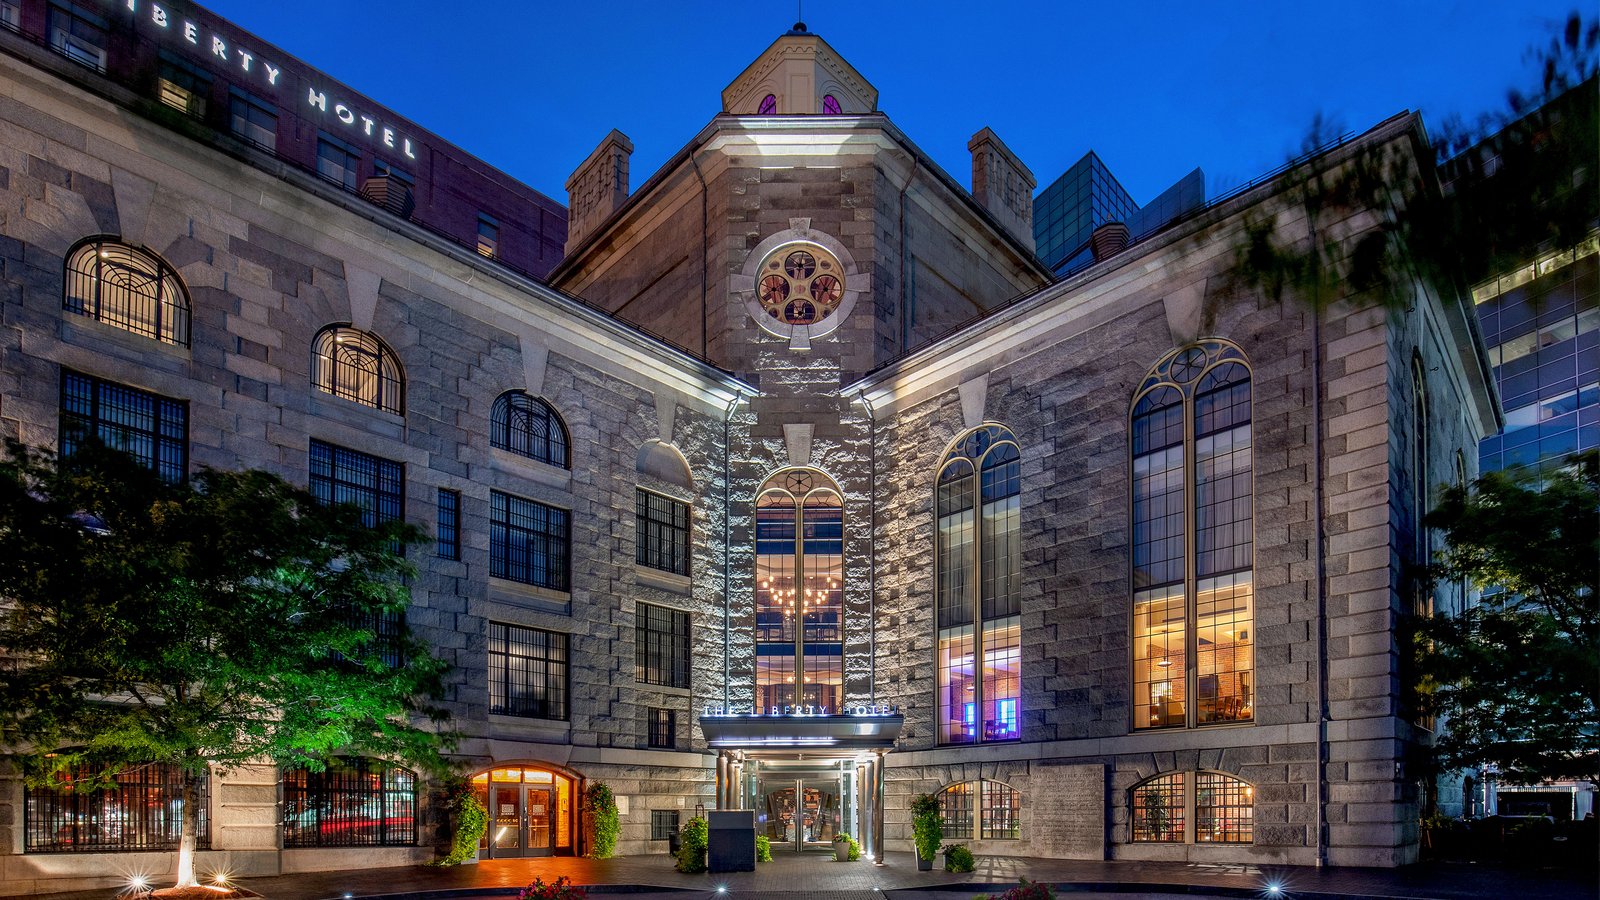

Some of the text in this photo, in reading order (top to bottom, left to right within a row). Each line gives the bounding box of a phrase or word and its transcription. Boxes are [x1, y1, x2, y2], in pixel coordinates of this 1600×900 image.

[308, 87, 416, 159] HOTEL
[703, 705, 737, 716] THE
[751, 705, 827, 716] LIBERTY
